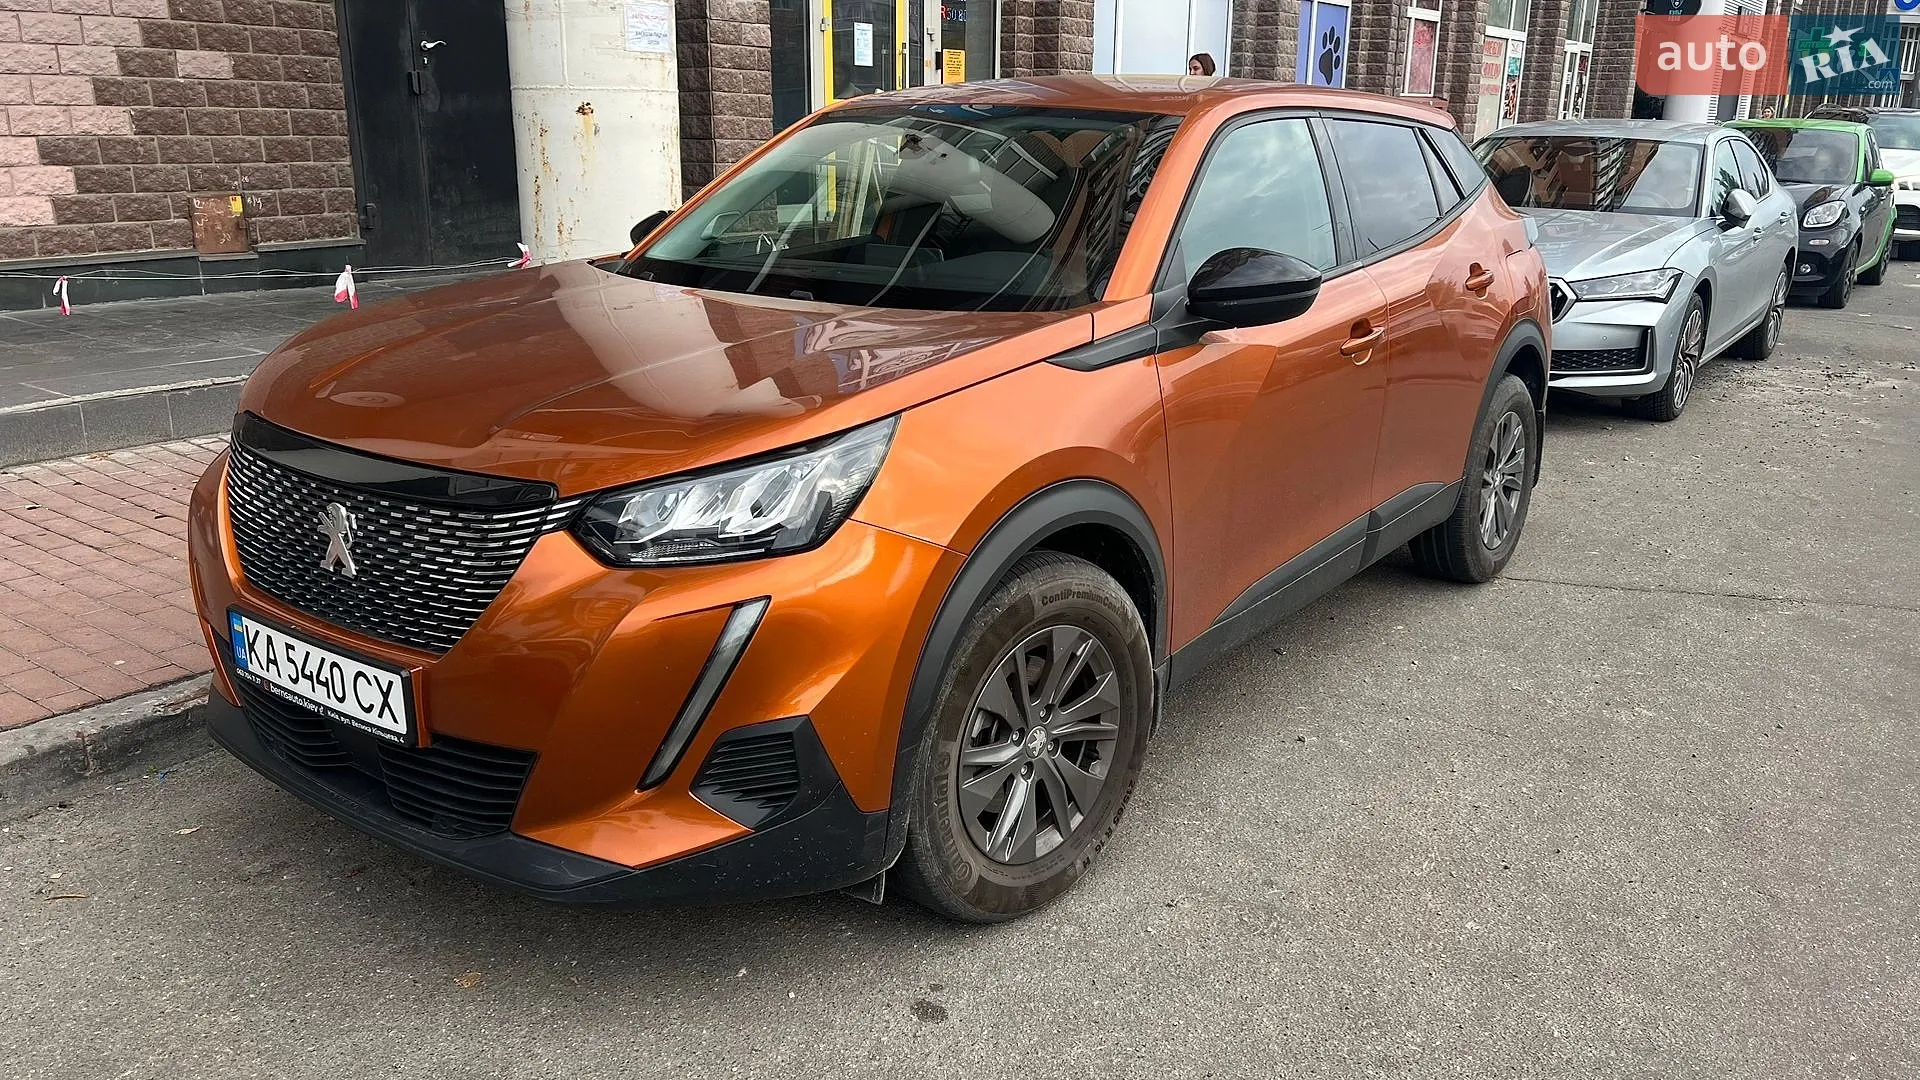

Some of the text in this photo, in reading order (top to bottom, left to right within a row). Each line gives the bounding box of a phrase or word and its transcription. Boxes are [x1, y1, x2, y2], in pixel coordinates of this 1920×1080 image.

[236, 645, 247, 660] UA
[245, 624, 400, 725] KA 5440 CX
